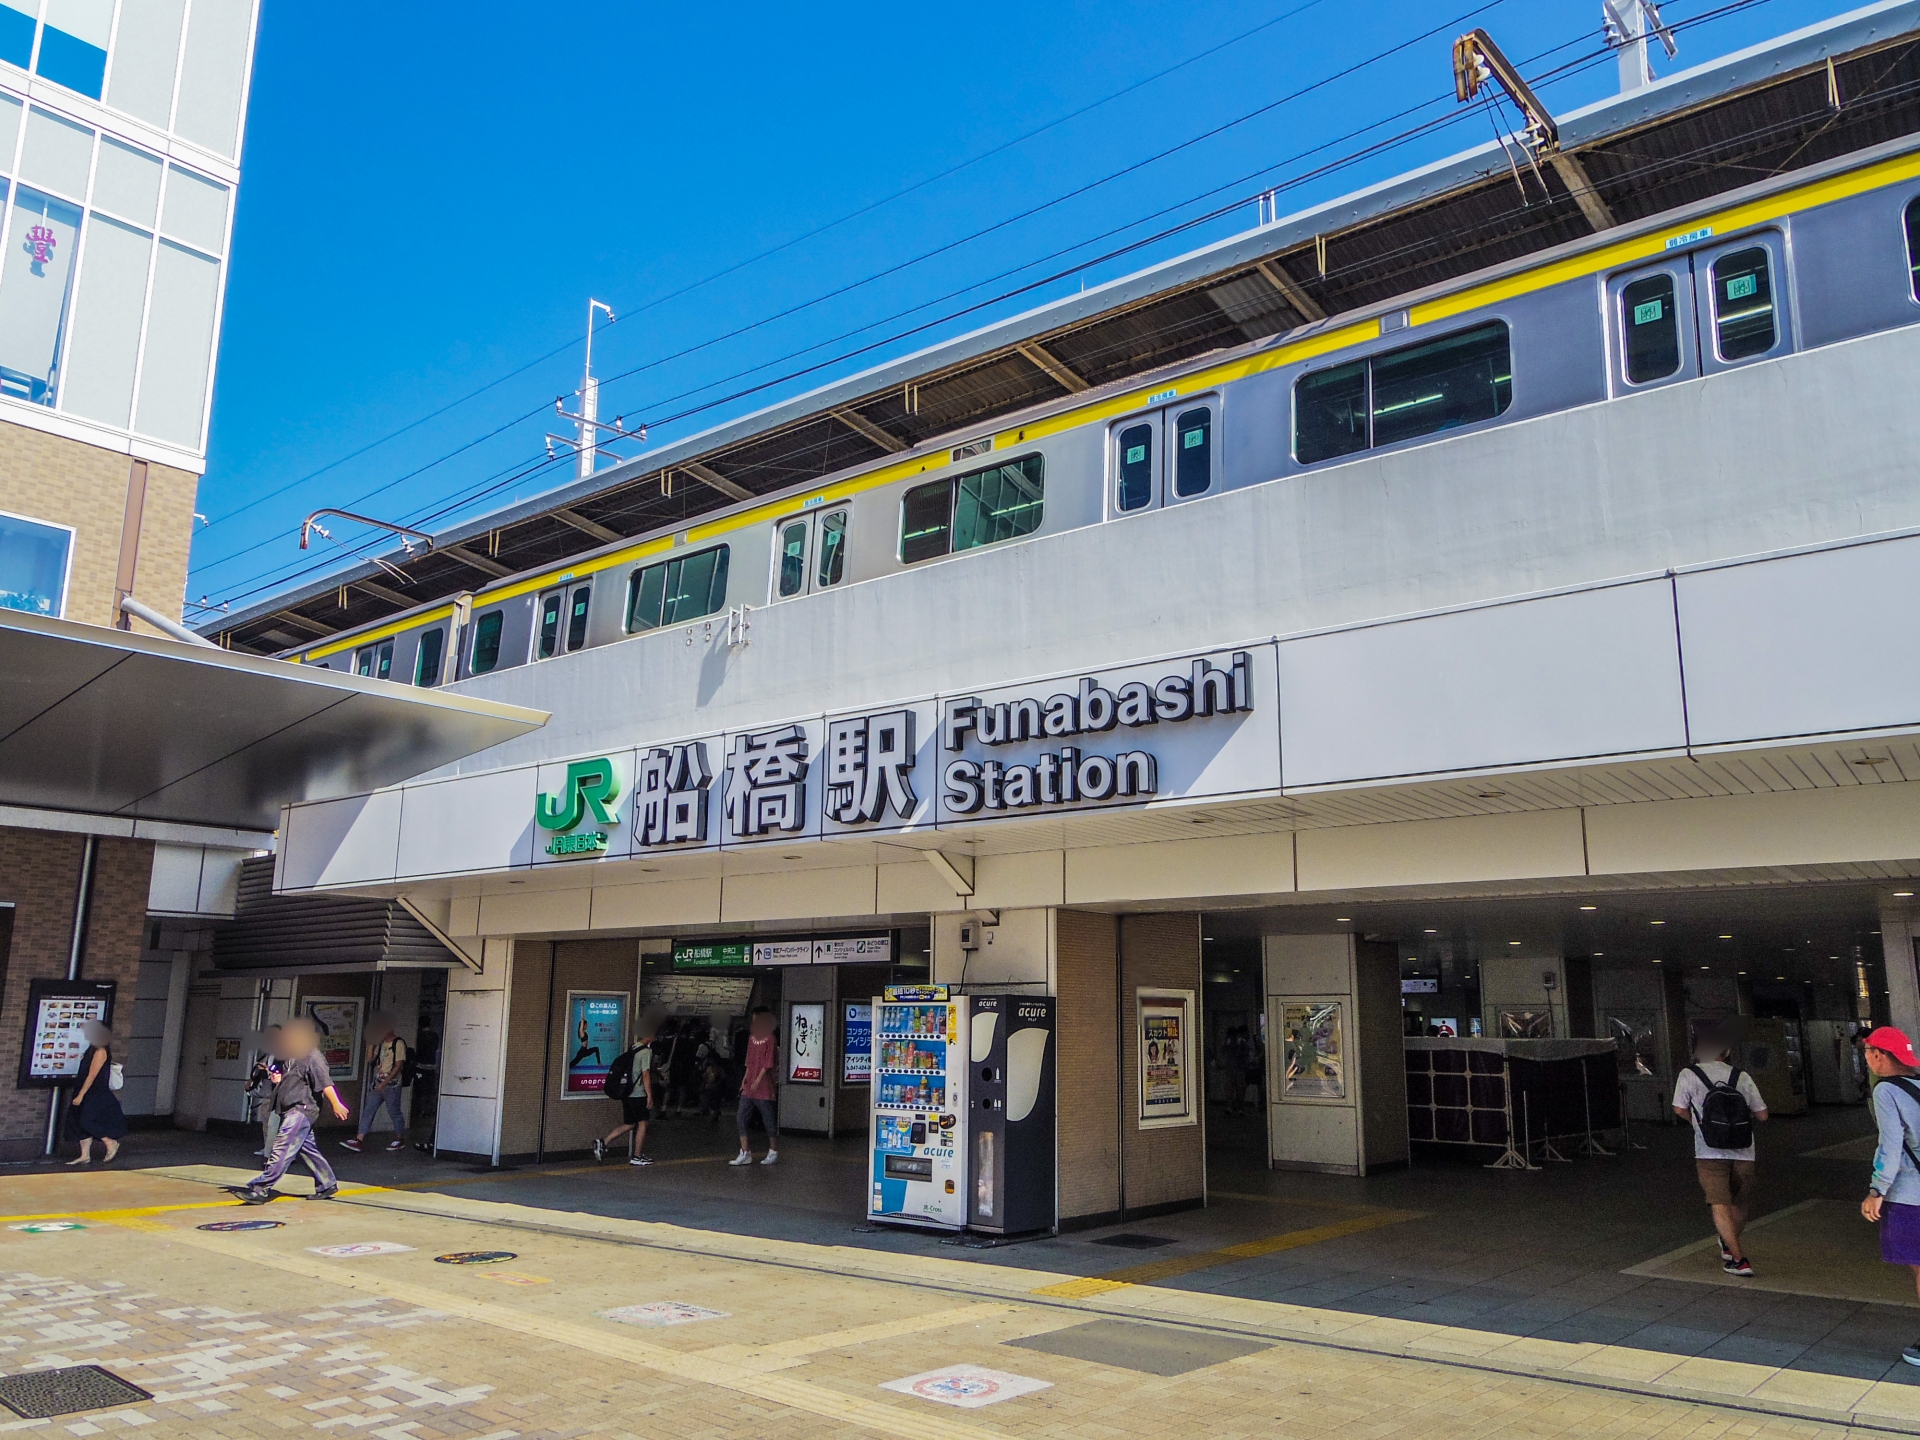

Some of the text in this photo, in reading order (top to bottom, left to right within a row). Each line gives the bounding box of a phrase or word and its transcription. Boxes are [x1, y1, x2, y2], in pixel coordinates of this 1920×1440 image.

[944, 651, 1254, 751] Funabashi
[537, 757, 621, 832] JR
[633, 709, 918, 845] 船橋駅
[943, 746, 1158, 814] Station
[545, 831, 608, 856] JR東日本
[682, 948, 694, 958] JR
[795, 1012, 808, 1056] ねぎし
[1018, 1007, 1046, 1018] acure
[924, 1147, 954, 1158] acure
